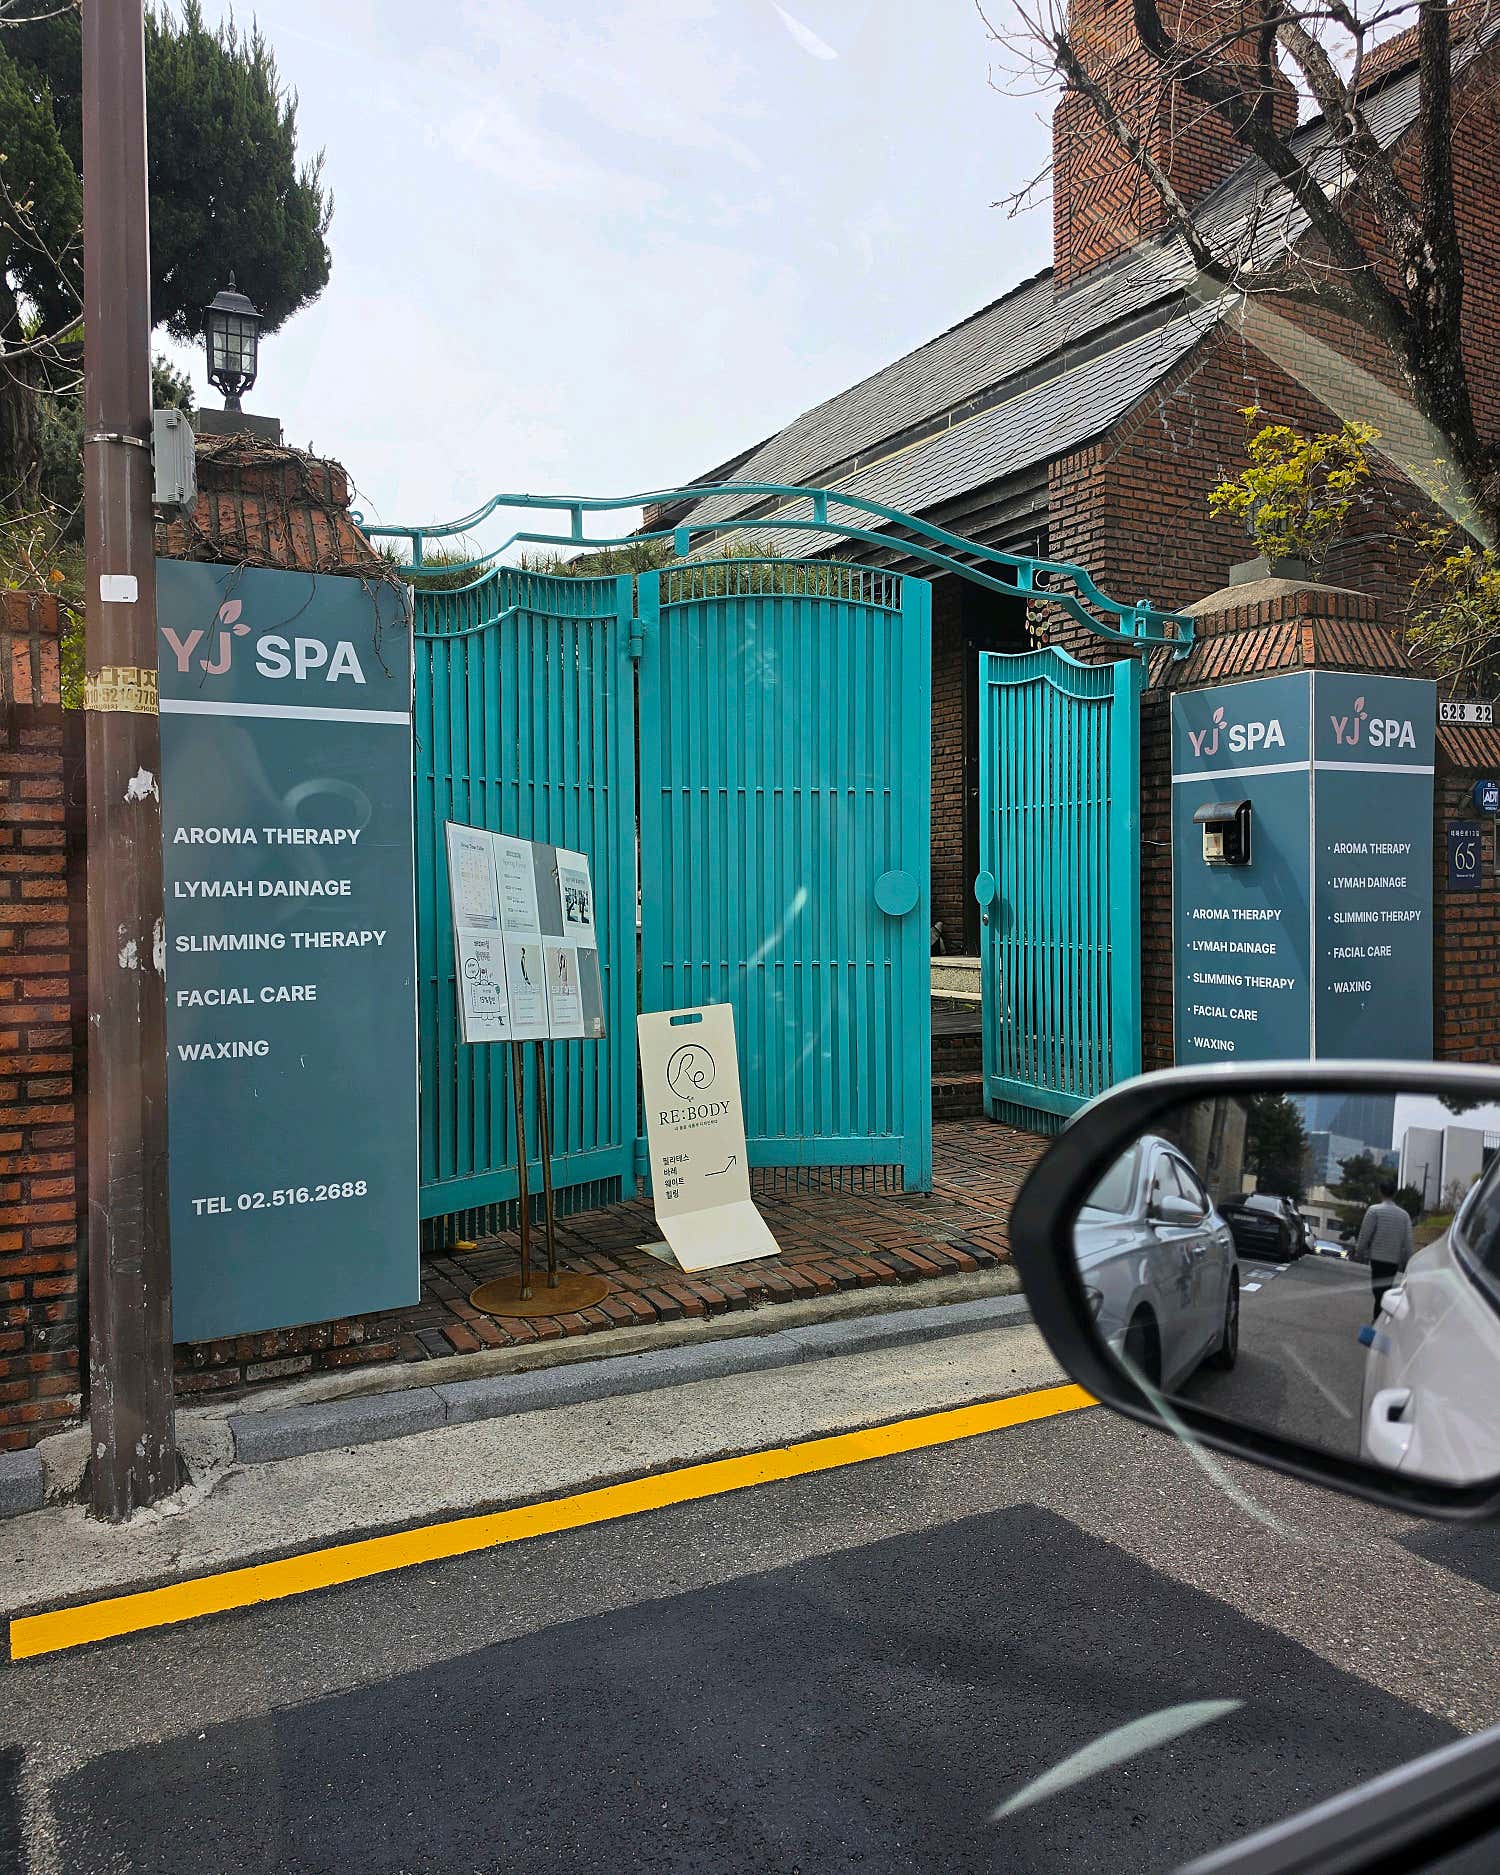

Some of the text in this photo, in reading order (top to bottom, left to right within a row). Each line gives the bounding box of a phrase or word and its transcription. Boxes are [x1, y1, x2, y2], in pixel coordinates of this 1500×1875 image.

[161, 627, 367, 684] YJ SPA
[1441, 704, 1492, 721] 623 22
[1228, 719, 1286, 752] SPA
[1368, 718, 1416, 749] SPA
[1483, 791, 1499, 804] ADT
[173, 827, 361, 845] AROMA THERAPY
[1333, 843, 1411, 854] AROMA THERAPY
[1455, 842, 1476, 870] 65
[174, 880, 352, 898] LYMAH DAINAGE
[1333, 877, 1407, 888] LYMAH DAINAGE
[1192, 909, 1281, 921] AROMA THERAPY
[1333, 910, 1421, 923] SLIMMING THERAPY
[175, 930, 387, 952] SLIMMING THERAPY
[1192, 940, 1276, 954] LYMAH DAINAGE
[1333, 945, 1392, 958] FACIAL CARE
[1193, 973, 1295, 990] SLIMMING THERAPY
[1333, 980, 1372, 993] WAXING
[176, 985, 317, 1007] FACIAL CARE
[1193, 1005, 1258, 1021] FACIAL CARE
[178, 1040, 270, 1061] WAXING
[1193, 1036, 1235, 1051] WAXING
[659, 1100, 730, 1126] RE:BODY
[192, 1180, 368, 1215] TEL 02.516.2688
